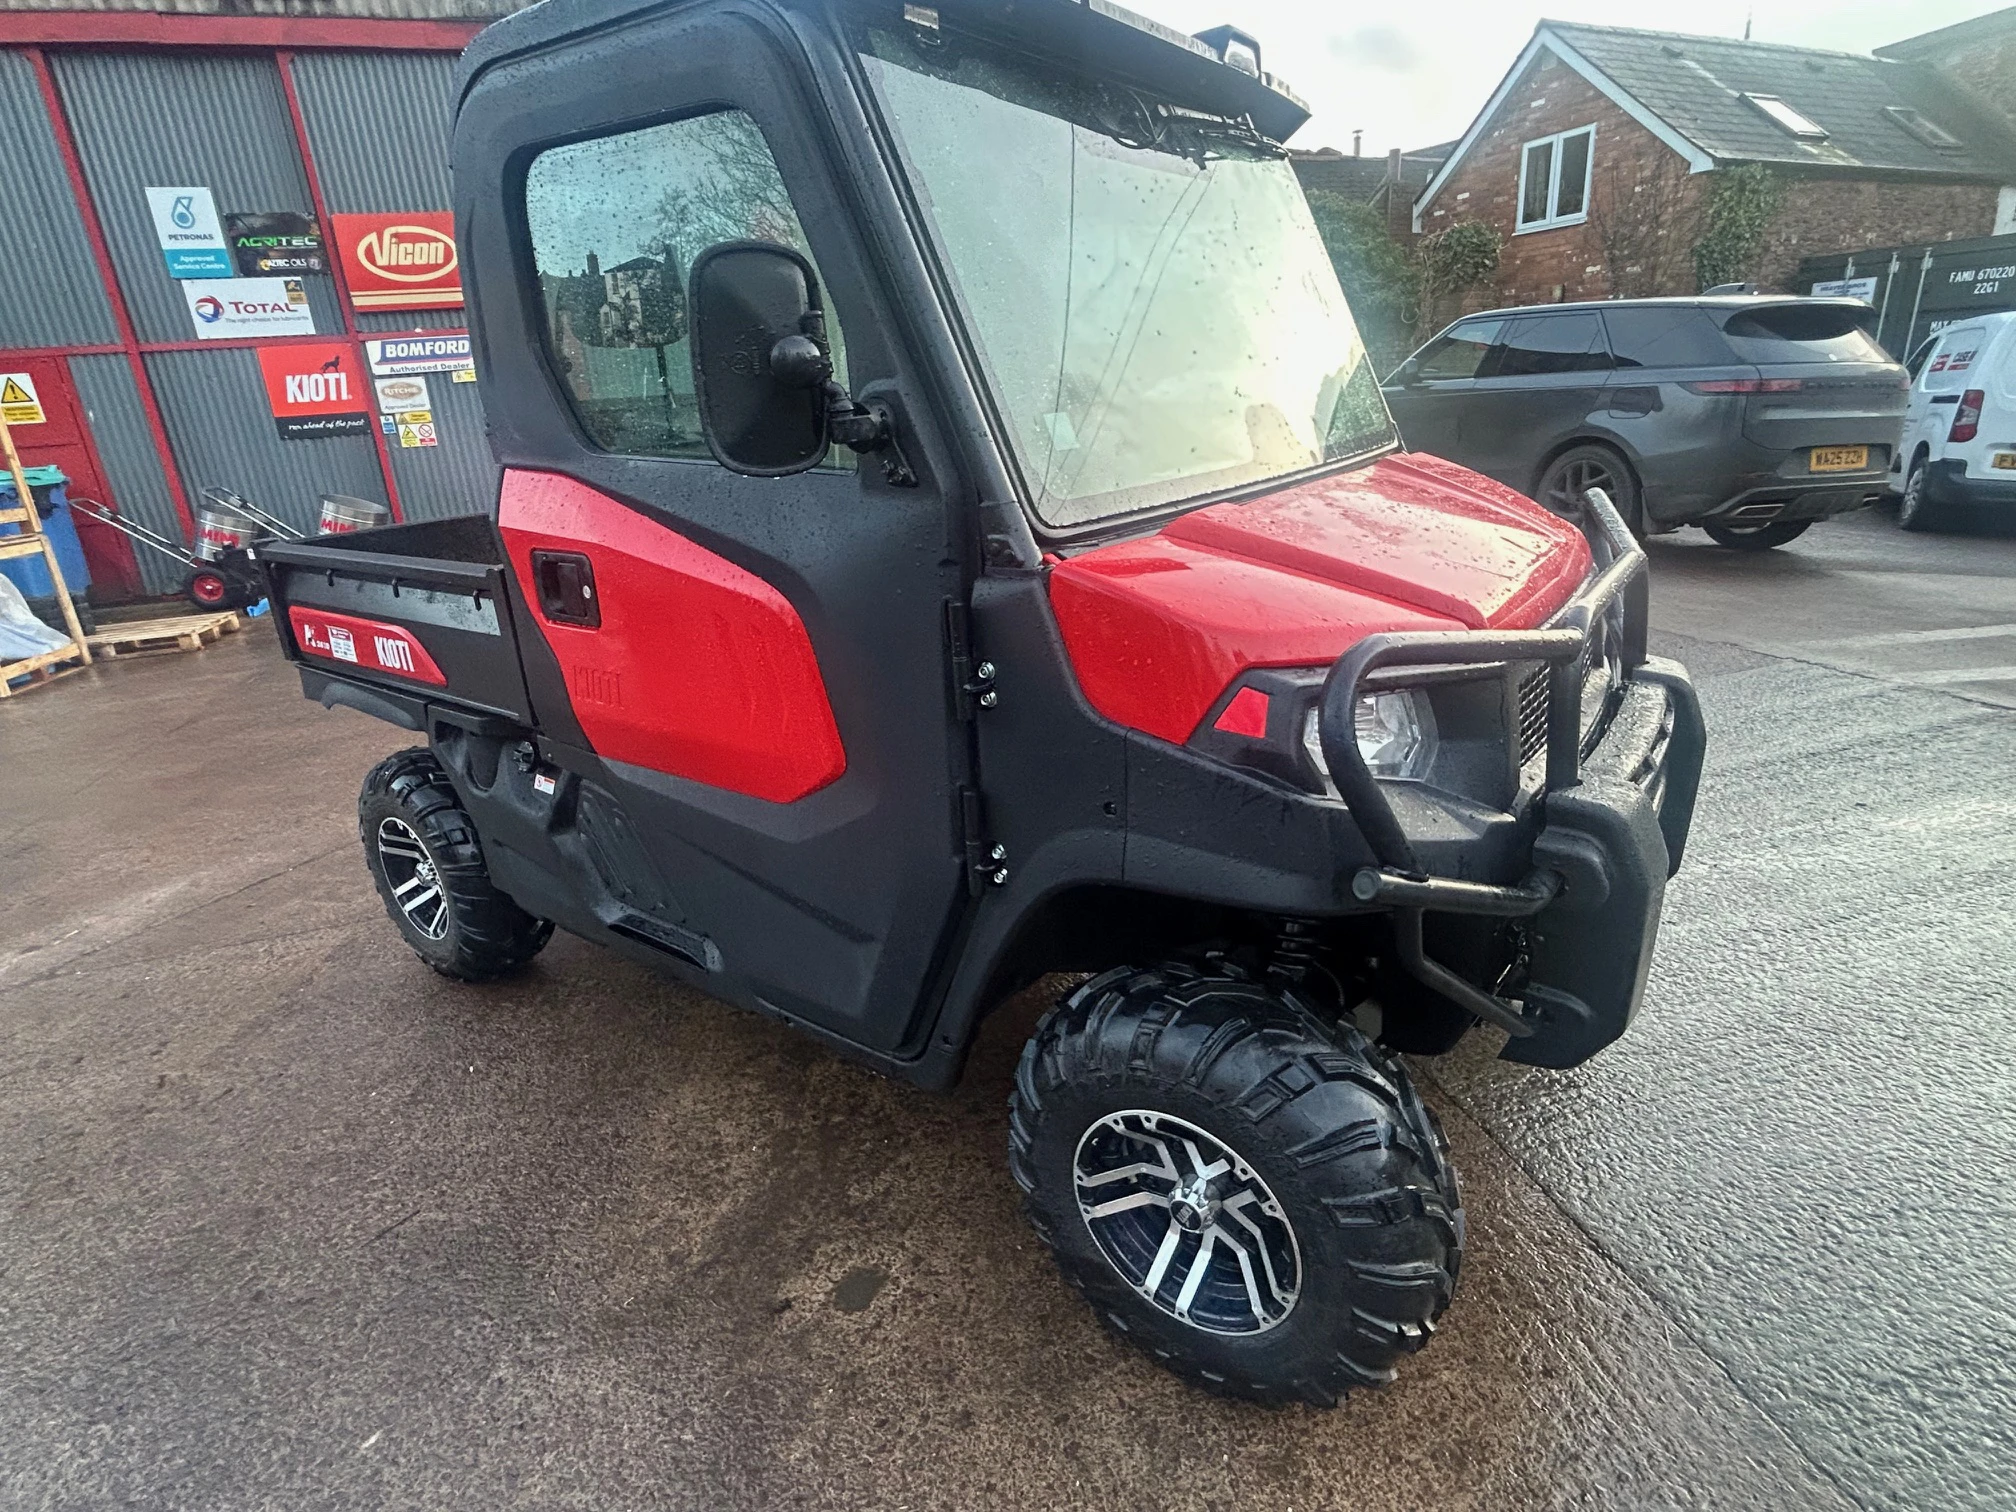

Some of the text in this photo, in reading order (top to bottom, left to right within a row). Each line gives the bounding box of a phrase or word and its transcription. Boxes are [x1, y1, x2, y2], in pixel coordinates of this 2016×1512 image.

[168, 233, 215, 241] PETRONAS
[237, 236, 318, 247] AGRITEC
[372, 228, 445, 266] Vicon
[1949, 265, 2016, 283] FAMU 670220
[385, 340, 470, 358] BOMFORD
[389, 362, 470, 373] Authorised Dealer
[286, 371, 348, 403] KIOTI
[374, 635, 415, 673] KIOTI
